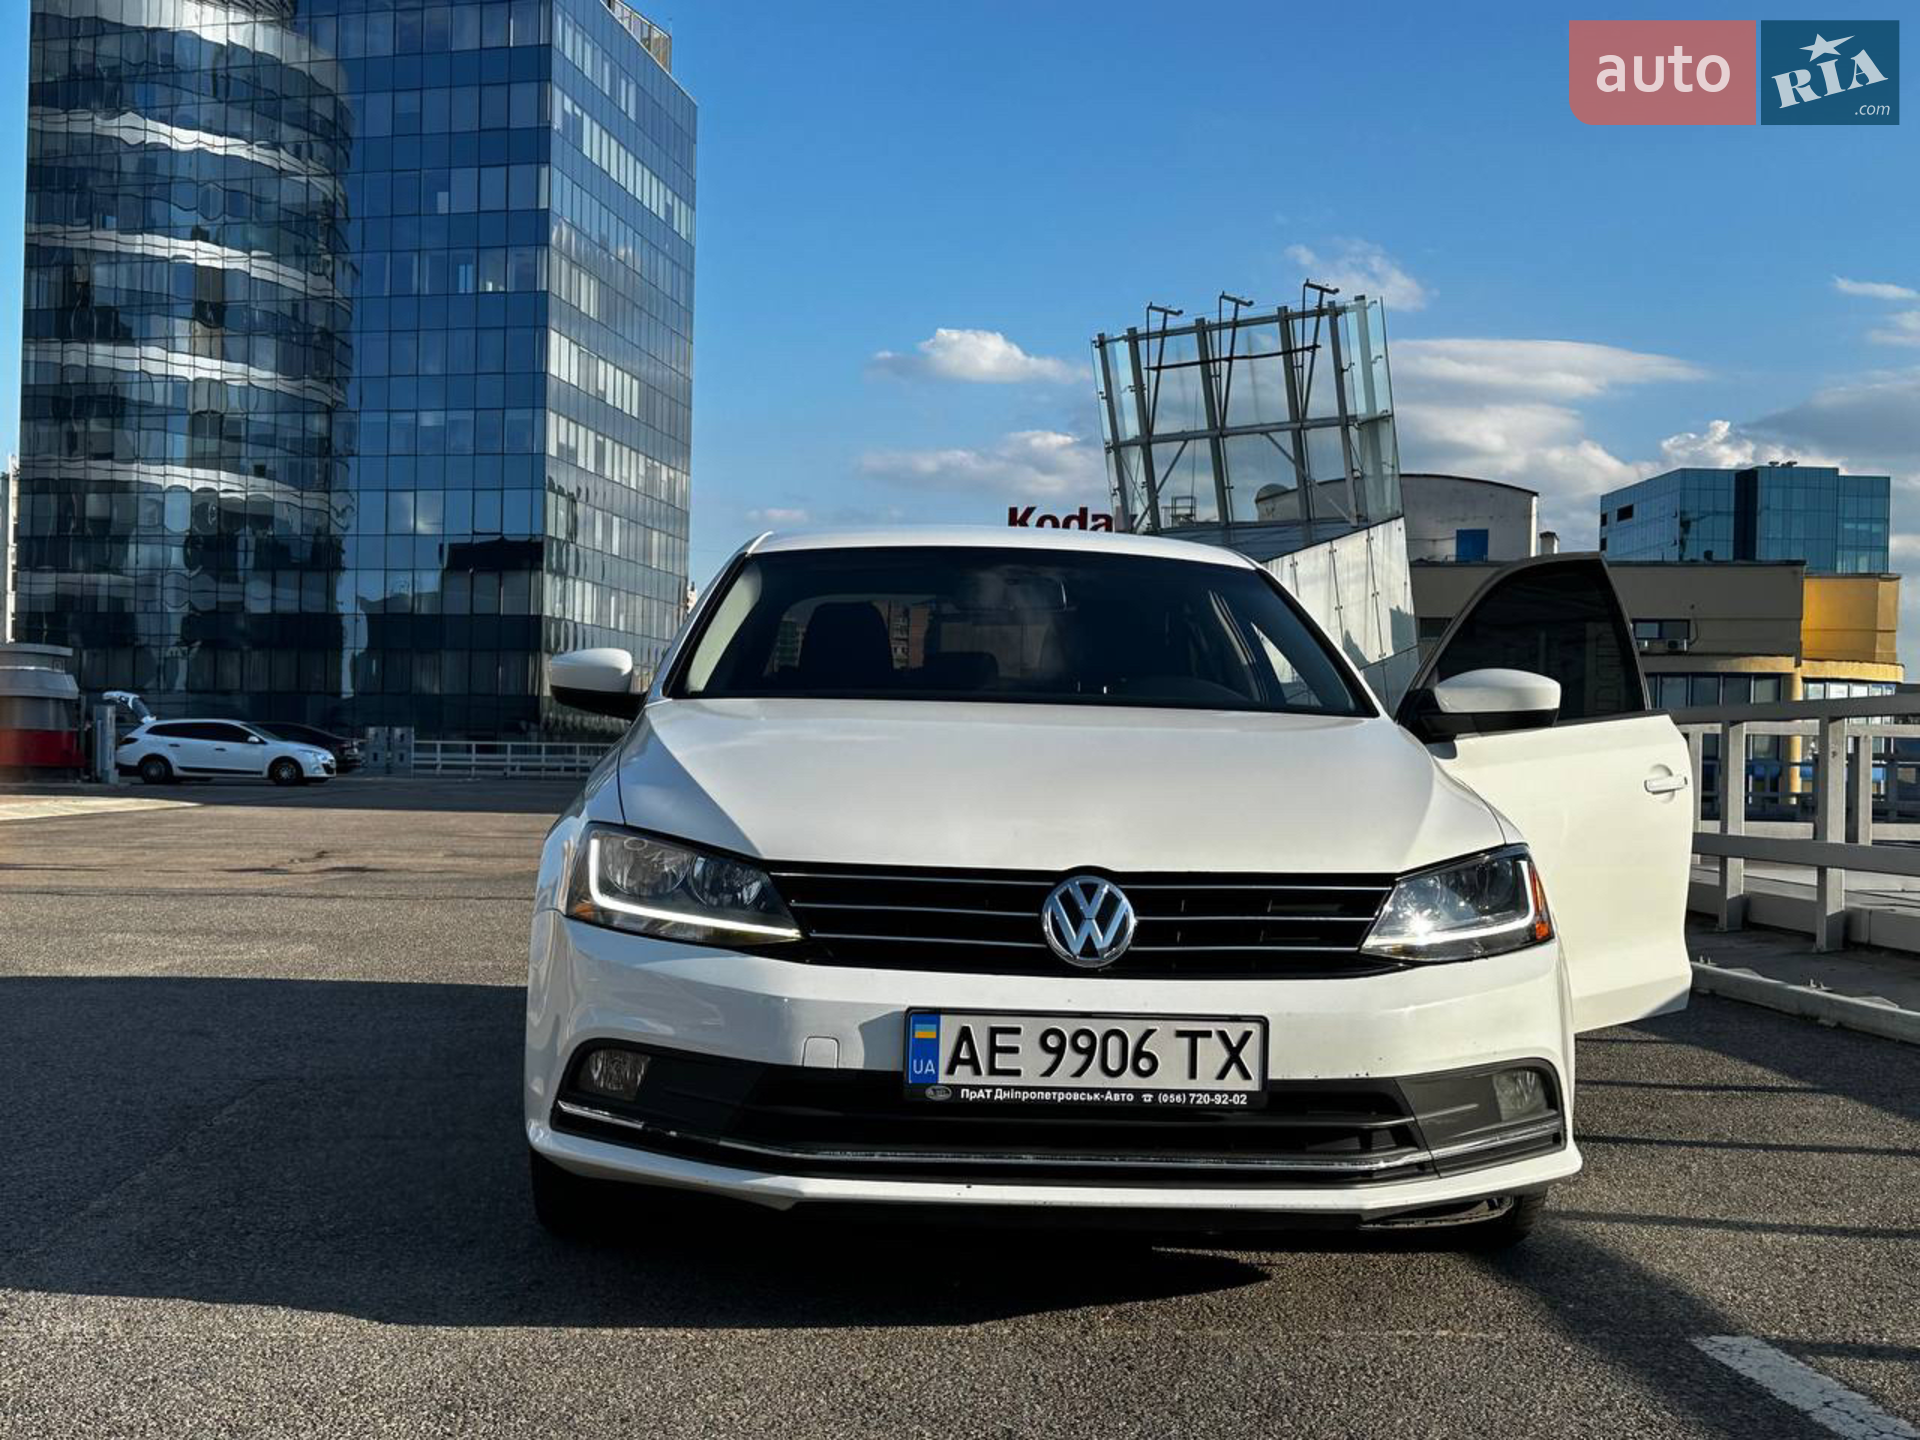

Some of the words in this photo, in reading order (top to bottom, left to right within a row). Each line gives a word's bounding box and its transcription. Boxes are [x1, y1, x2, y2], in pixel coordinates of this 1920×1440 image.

[946, 1026, 1022, 1077] AE
[1039, 1027, 1159, 1078] 9906
[1175, 1029, 1254, 1081] TX
[913, 1059, 936, 1075] UA
[960, 1088, 993, 1101] ПрАТ
[1158, 1092, 1186, 1104] (056)
[1189, 1093, 1247, 1105] 720-92-02
